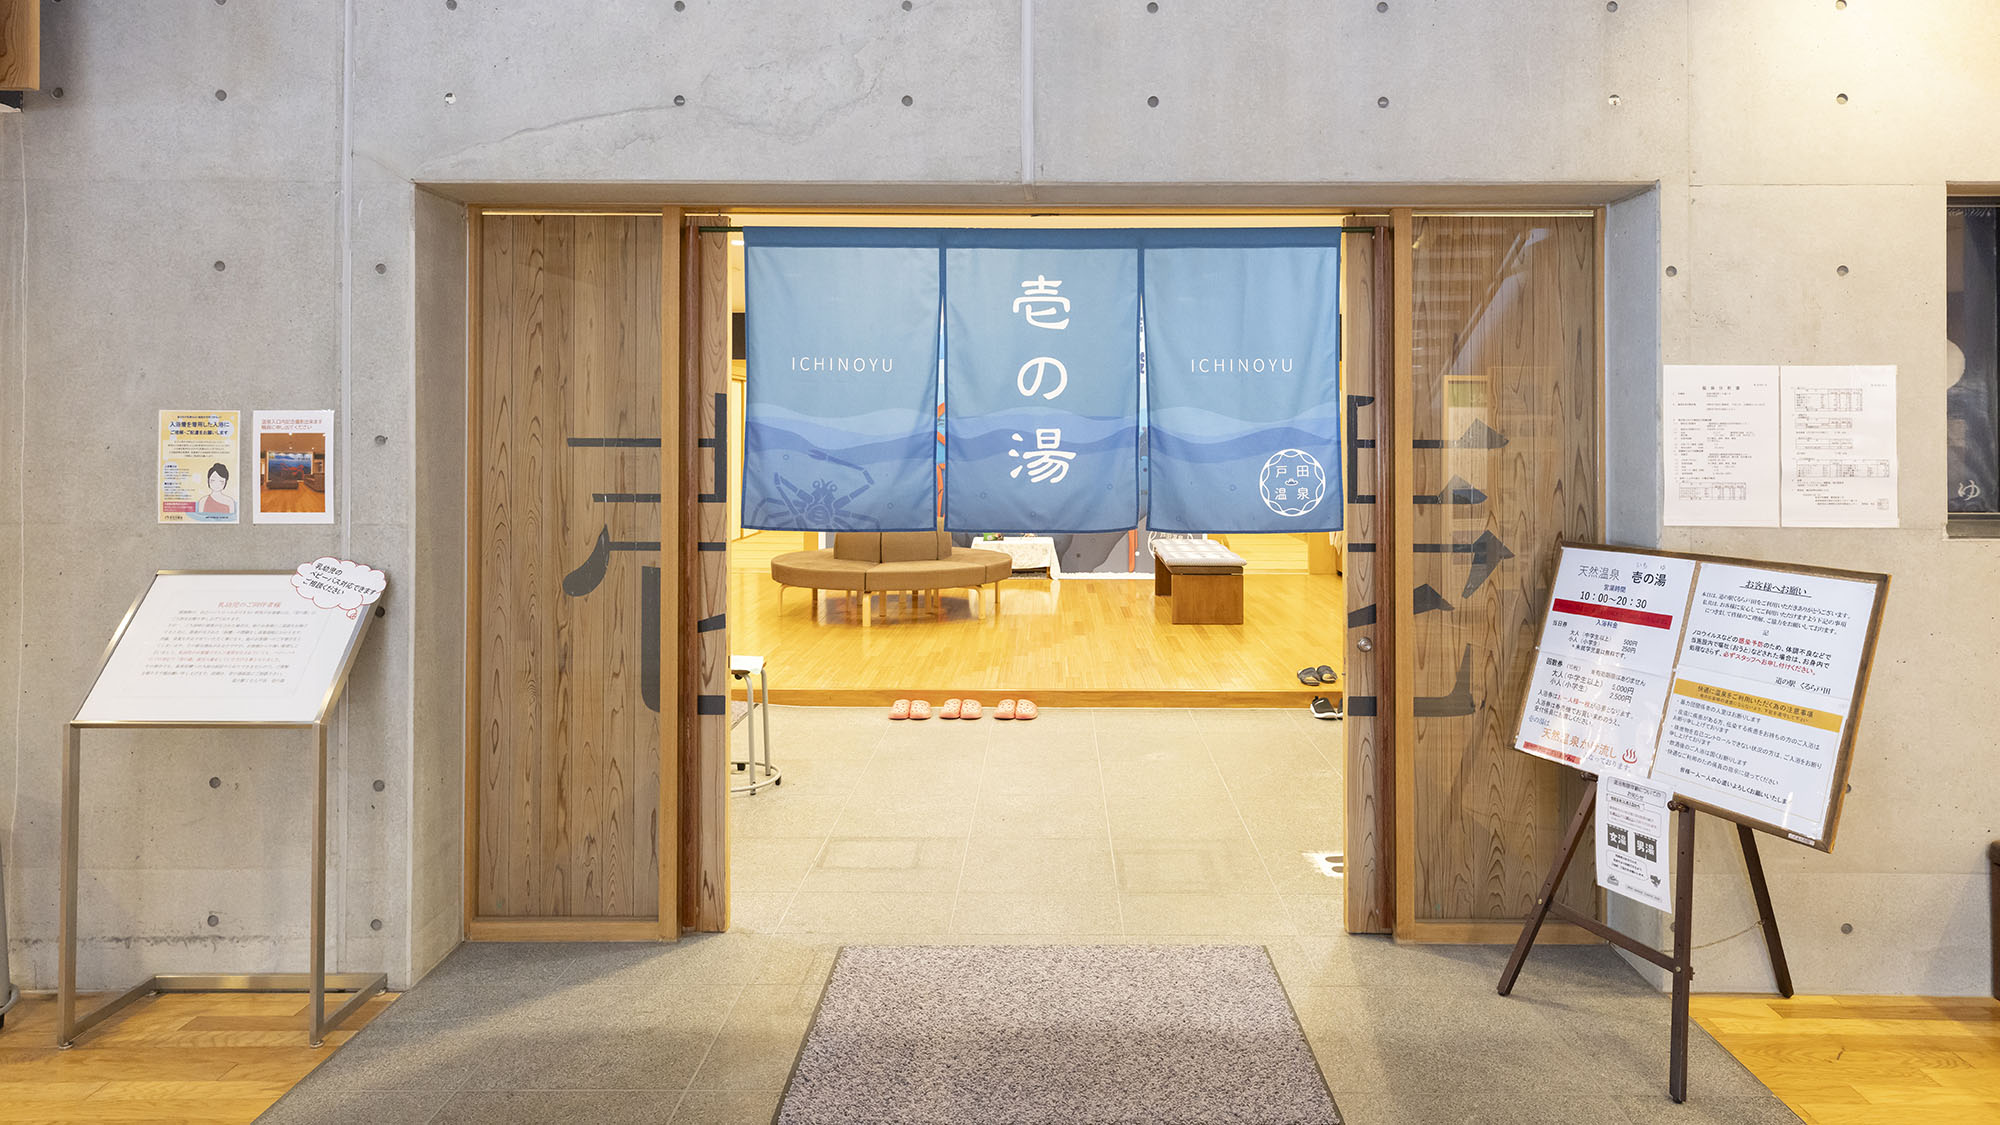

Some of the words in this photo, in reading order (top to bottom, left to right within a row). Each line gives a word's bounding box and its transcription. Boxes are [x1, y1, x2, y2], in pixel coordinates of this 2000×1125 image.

[791, 357, 894, 373] ICHINOYU
[1190, 357, 1293, 374] ICHINOYU
[1008, 274, 1078, 485] 壱の湯
[1275, 465, 1310, 479] 戸田
[1275, 487, 1310, 501] 温泉
[1957, 479, 1981, 501] ゆ
[1577, 564, 1622, 581] 天然温泉
[1630, 570, 1668, 587] 壱の湯
[303, 578, 345, 595] ご相談ください
[1744, 579, 1808, 596] お客様へお願い
